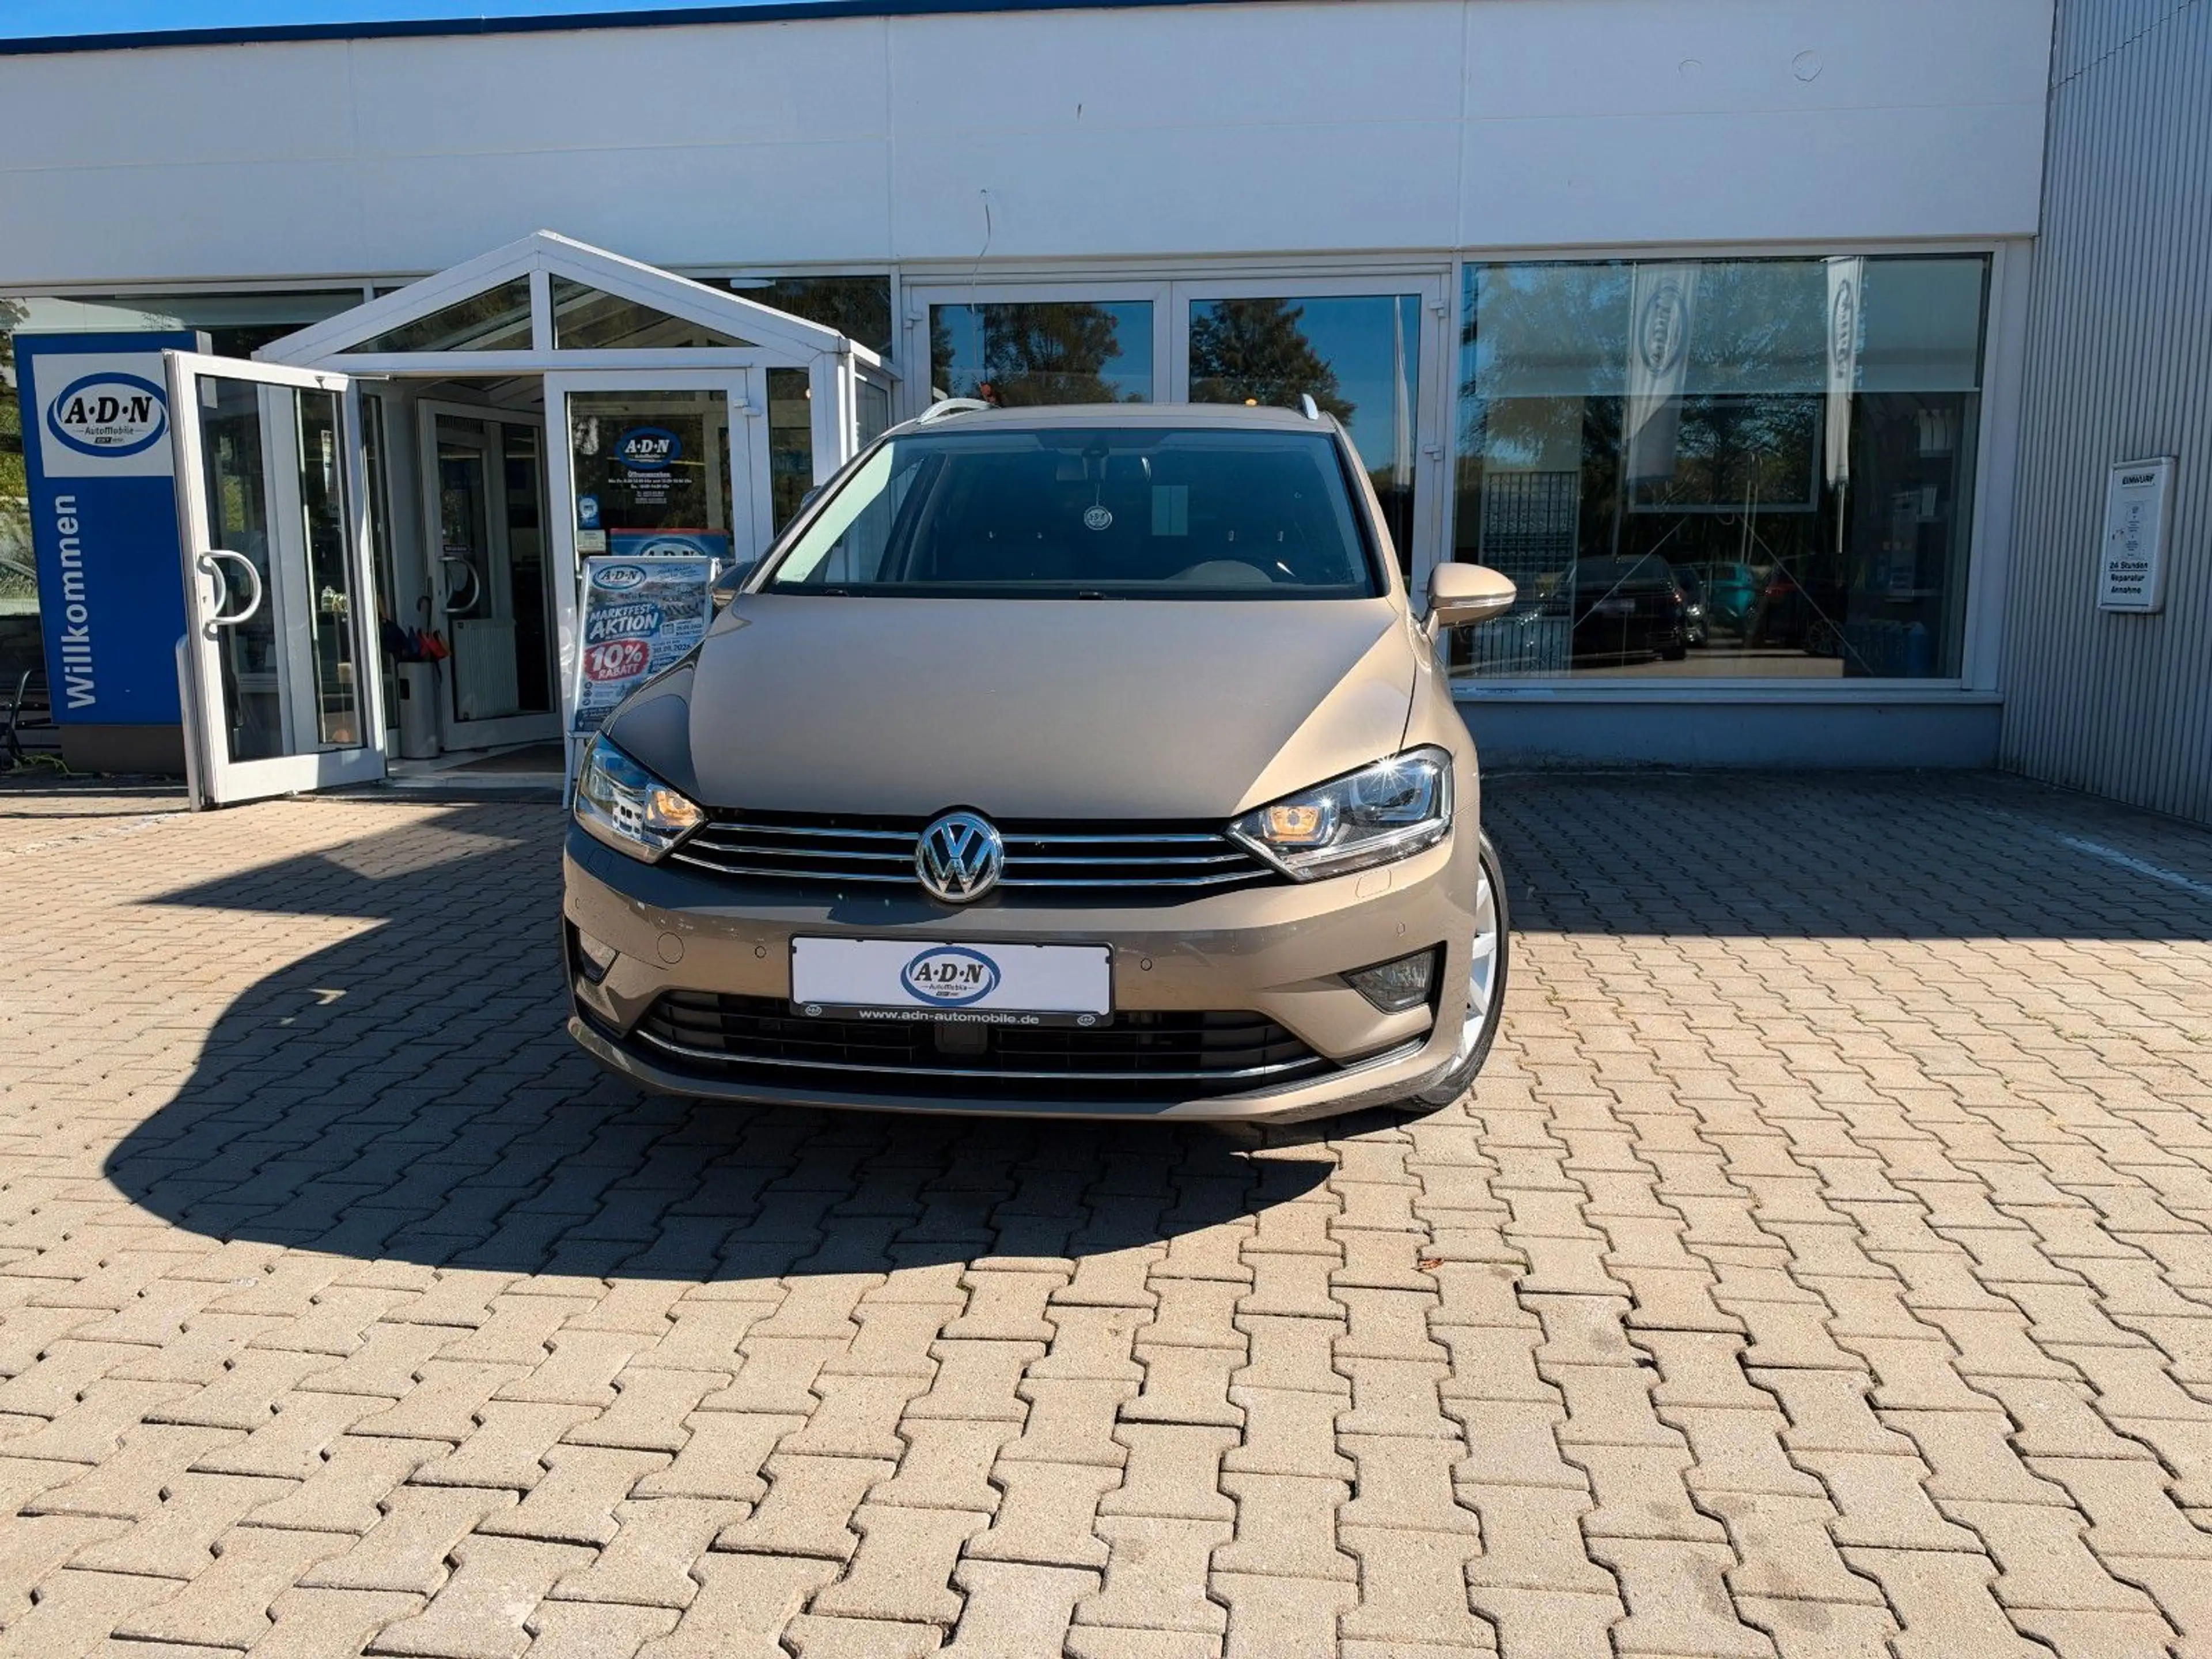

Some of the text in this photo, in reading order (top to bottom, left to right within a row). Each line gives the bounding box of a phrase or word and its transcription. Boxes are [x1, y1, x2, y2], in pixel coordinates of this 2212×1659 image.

[55, 495, 96, 709] Willkommen
[589, 612, 659, 639] AKTION
[591, 643, 643, 672] 10%
[599, 664, 639, 679] RABATT
[859, 1010, 1039, 1024] www.adn-automobile.de
